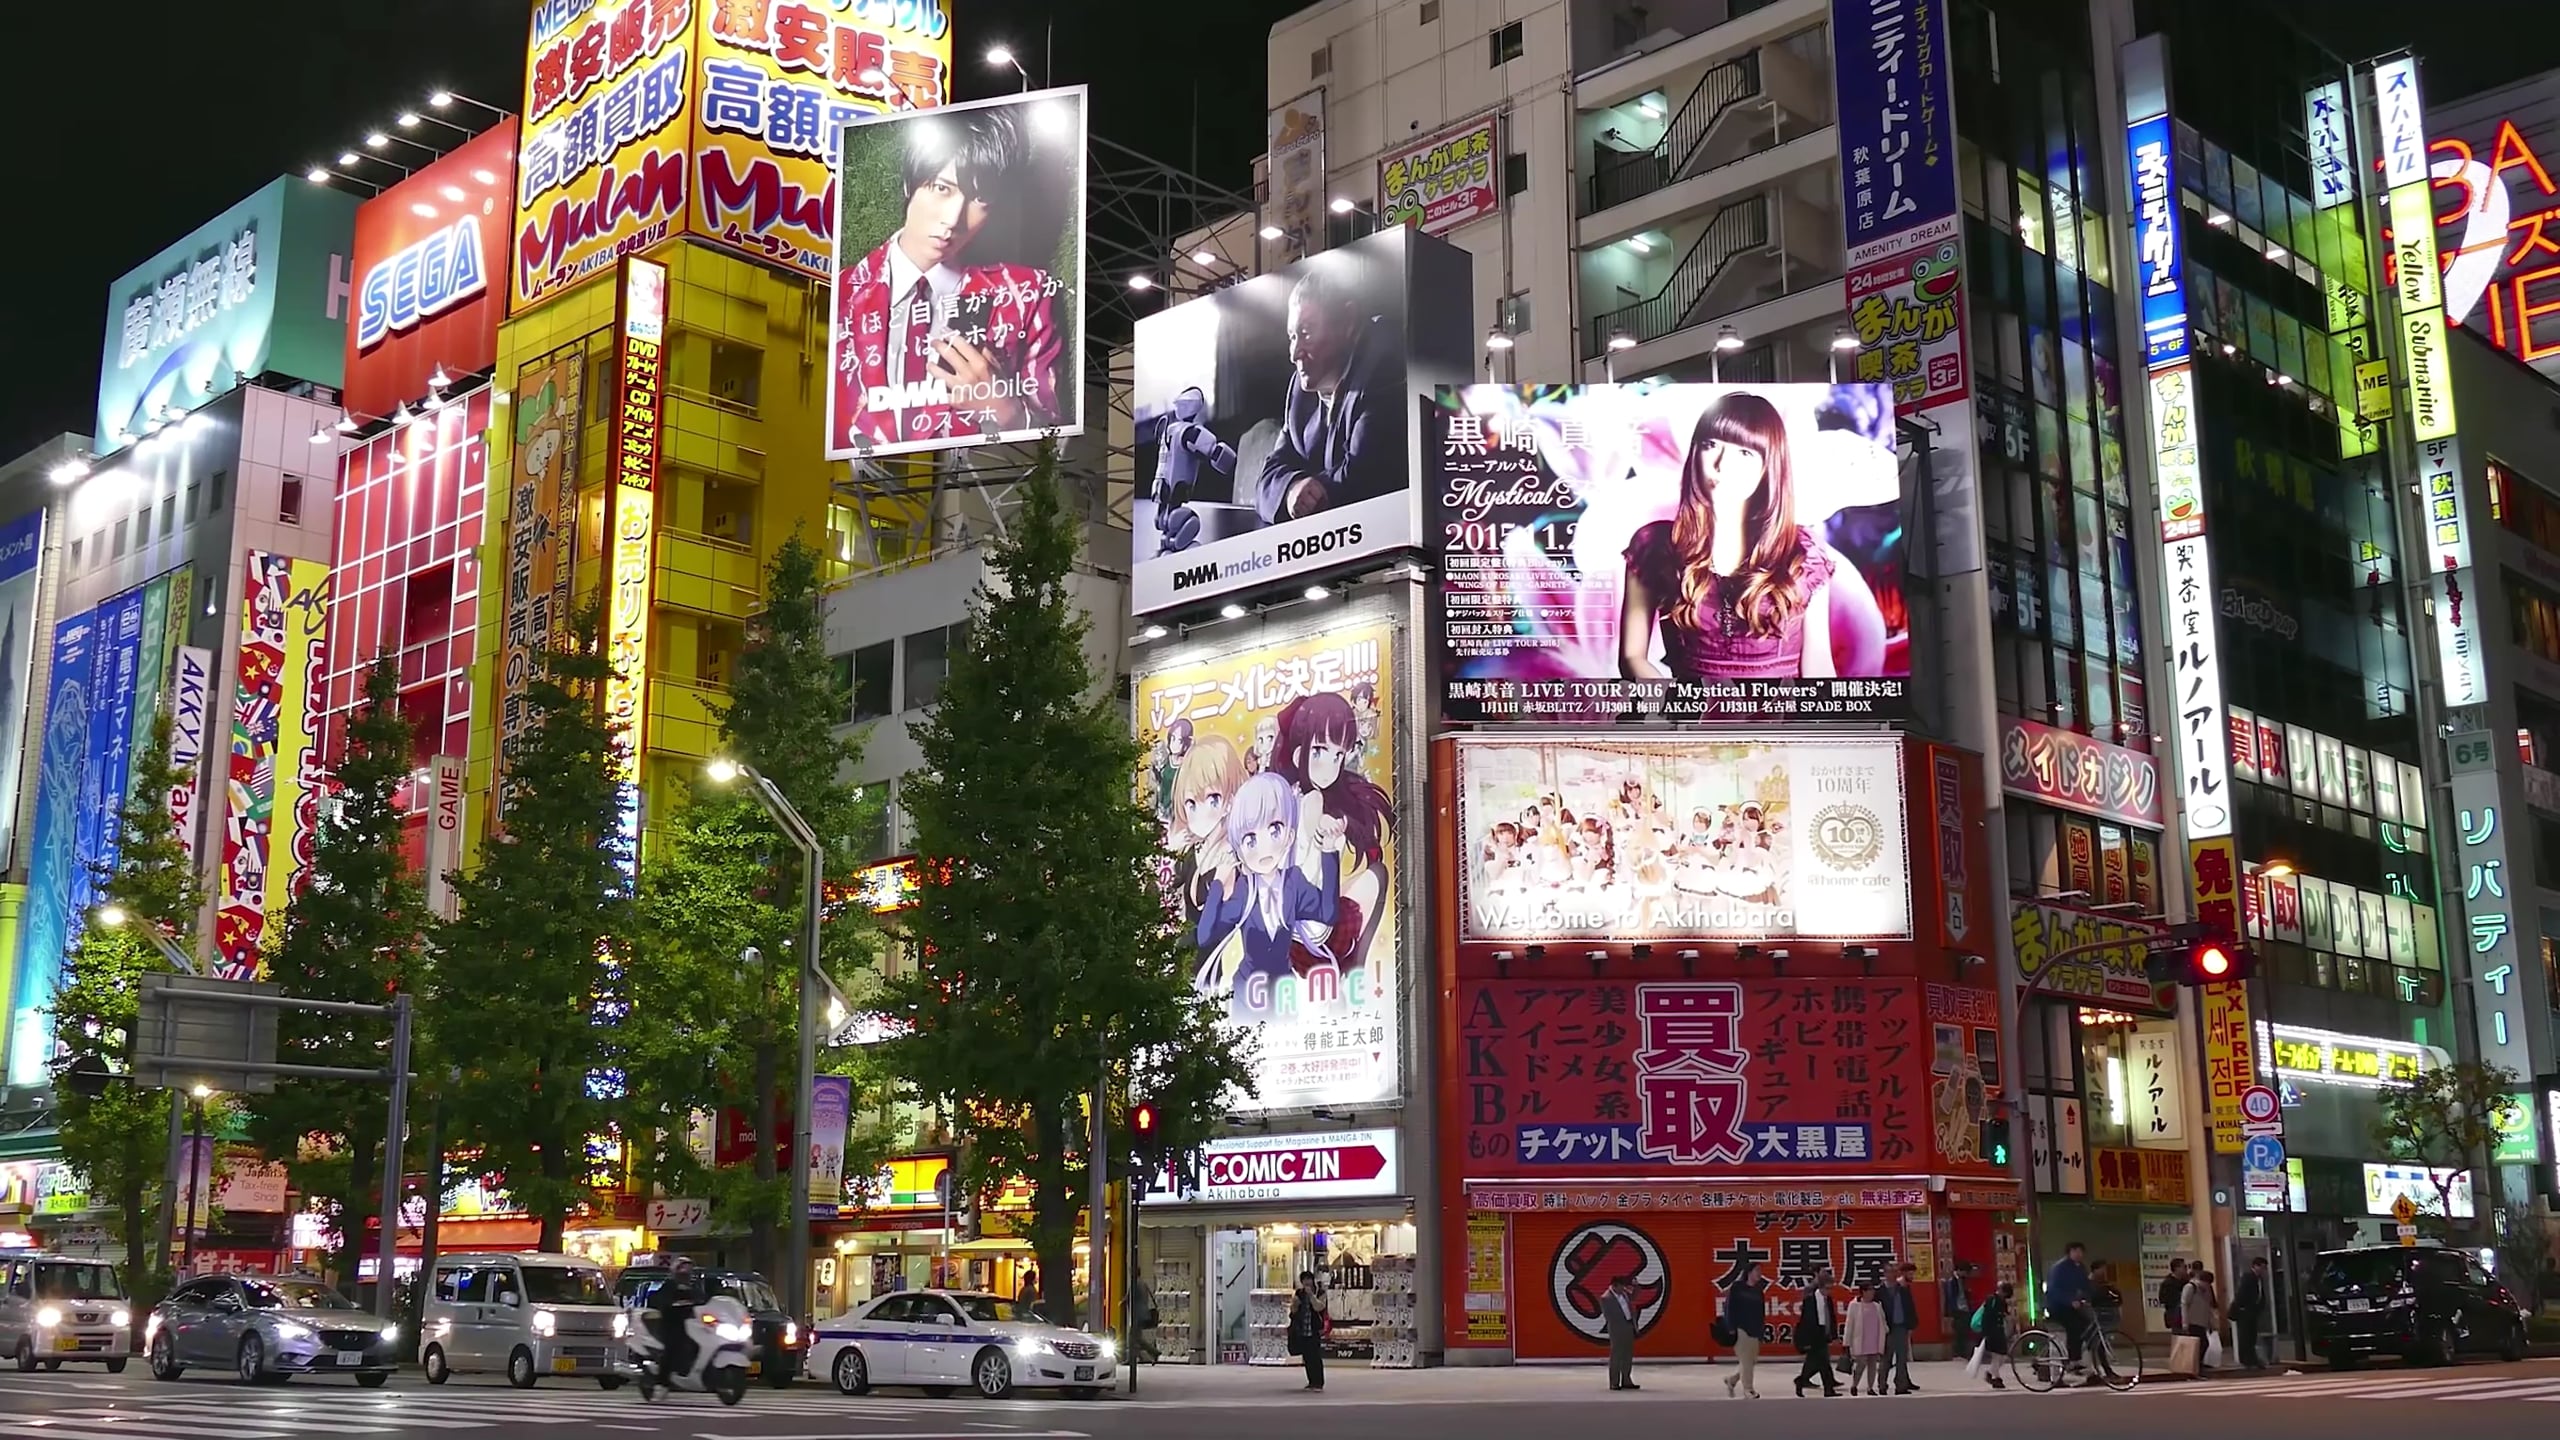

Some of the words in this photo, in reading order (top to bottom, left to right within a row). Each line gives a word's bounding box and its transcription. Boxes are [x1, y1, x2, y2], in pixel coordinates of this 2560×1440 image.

[530, 0, 689, 122] 激安販売
[713, 0, 943, 108] 激安販売
[523, 48, 686, 207] 高額買取
[1870, 0, 1917, 220] ニティードリーム
[1384, 128, 1490, 198] まんが喫茶
[1852, 145, 1875, 231] 秋葉原店
[519, 150, 685, 298] Mulan
[724, 223, 800, 261] ムーラン
[1854, 237, 1903, 262] AMENITY
[1910, 222, 1951, 243] DREAM
[357, 214, 487, 350] SEGA
[531, 263, 578, 300] ムーラン
[580, 246, 615, 279] AKIBA
[2401, 239, 2424, 303] Yellow
[1853, 294, 1957, 345] まんが
[628, 339, 657, 358] DVD
[1856, 341, 1921, 383] 喫茶
[627, 372, 656, 392] ゲーム
[1932, 368, 1957, 387] 3F
[2410, 320, 2439, 427] Submarine
[629, 389, 651, 406] CD
[867, 378, 948, 412] DMM
[951, 374, 1039, 402] mobile
[2156, 372, 2187, 449] まんが
[622, 421, 654, 439] アニメ
[624, 405, 654, 423] アイドル
[912, 407, 997, 432] のスマホ
[622, 438, 652, 456] コミック
[2004, 424, 2030, 462] 6F
[2427, 440, 2449, 457] 5F
[623, 455, 651, 471] ホビー
[1444, 458, 1537, 473] ニューアルバム
[1443, 475, 1554, 522] Mystical
[1173, 551, 1273, 591] DMM.make
[1277, 524, 1363, 564] ROBOTS
[1453, 573, 1480, 581] MAON
[1451, 624, 1513, 635] 初回封入特典
[2017, 592, 2042, 630] 5F
[496, 481, 536, 822] 激安販売の専門店
[1493, 640, 1512, 648] LIVE
[1515, 640, 1538, 648] TOUR
[2176, 545, 2222, 796] 喫茶室ルノアール
[174, 653, 205, 743] AKKY
[1449, 682, 1515, 699] 黒崎真音
[1521, 683, 1565, 697] LIVE
[1571, 683, 1622, 698] TOUR
[1628, 683, 1663, 698] 2016
[1831, 681, 1903, 697] 開催決定!
[1481, 702, 1518, 714] 1月11日
[1636, 702, 1660, 713] 梅田
[1762, 701, 1798, 713] 名古屋
[1800, 702, 1843, 712] SPADE
[1846, 702, 1872, 712] BOX
[1810, 765, 1876, 777] おかげさまで
[2003, 725, 2155, 815] メイドカジノ
[2455, 740, 2490, 766] 6号
[439, 766, 460, 831] GAME
[1817, 778, 1872, 795] 10周年
[1827, 826, 1855, 843] 10
[1935, 757, 1968, 888] 買取
[1860, 874, 1891, 887] cafe
[1476, 902, 1605, 931] Welcome
[1613, 905, 1640, 930] to
[1649, 903, 1796, 930] Akihabara
[1951, 895, 1963, 930] 入口
[2460, 807, 2511, 1045] リバティー
[2012, 904, 2149, 978] まんが喫茶
[1304, 1026, 1384, 1051] 得能正太郎
[1514, 988, 1550, 1116] アイドル
[1553, 988, 1590, 1082] アニメ
[1791, 987, 1825, 1081] ホビー
[1831, 985, 1872, 1119] 携帯電話
[2139, 1039, 2165, 1050] 喫茶室
[1589, 986, 1631, 1121] 美少女系
[1756, 988, 1791, 1119] フィギュア
[2230, 1020, 2250, 1098] FREE
[1634, 982, 1753, 1165] 買取
[1872, 987, 1914, 1161] アップルとか
[2146, 1053, 2168, 1134] ルノアール
[2250, 1097, 2271, 1113] 40
[1246, 1138, 1273, 1150] Support
[1274, 1137, 1284, 1147] for
[1285, 1135, 1320, 1148] Magazine
[1321, 1135, 1327, 1144] &
[1520, 1127, 1633, 1160] チケット
[1757, 1125, 1868, 1159] 大黒屋
[2253, 1145, 2269, 1167] P
[2264, 1156, 2276, 1167] 60
[239, 1180, 279, 1191] Tax-free
[1210, 1151, 1296, 1184] COMIC
[1301, 1150, 1340, 1180] ZIN
[2145, 1154, 2162, 1180] TAX
[2163, 1154, 2185, 1181] FREE
[253, 1192, 279, 1204] Shop
[1207, 1186, 1281, 1200] Akihabara
[1474, 1193, 1538, 1208] 高価買取
[1861, 1190, 1924, 1205] 無料査定
[654, 1204, 701, 1226] ラーメン
[1754, 1209, 1855, 1232] チケット
[2143, 1222, 2190, 1235] 比价店
[1712, 1237, 1898, 1292] 大黒屋
[2143, 1252, 2169, 1260] Nikon
